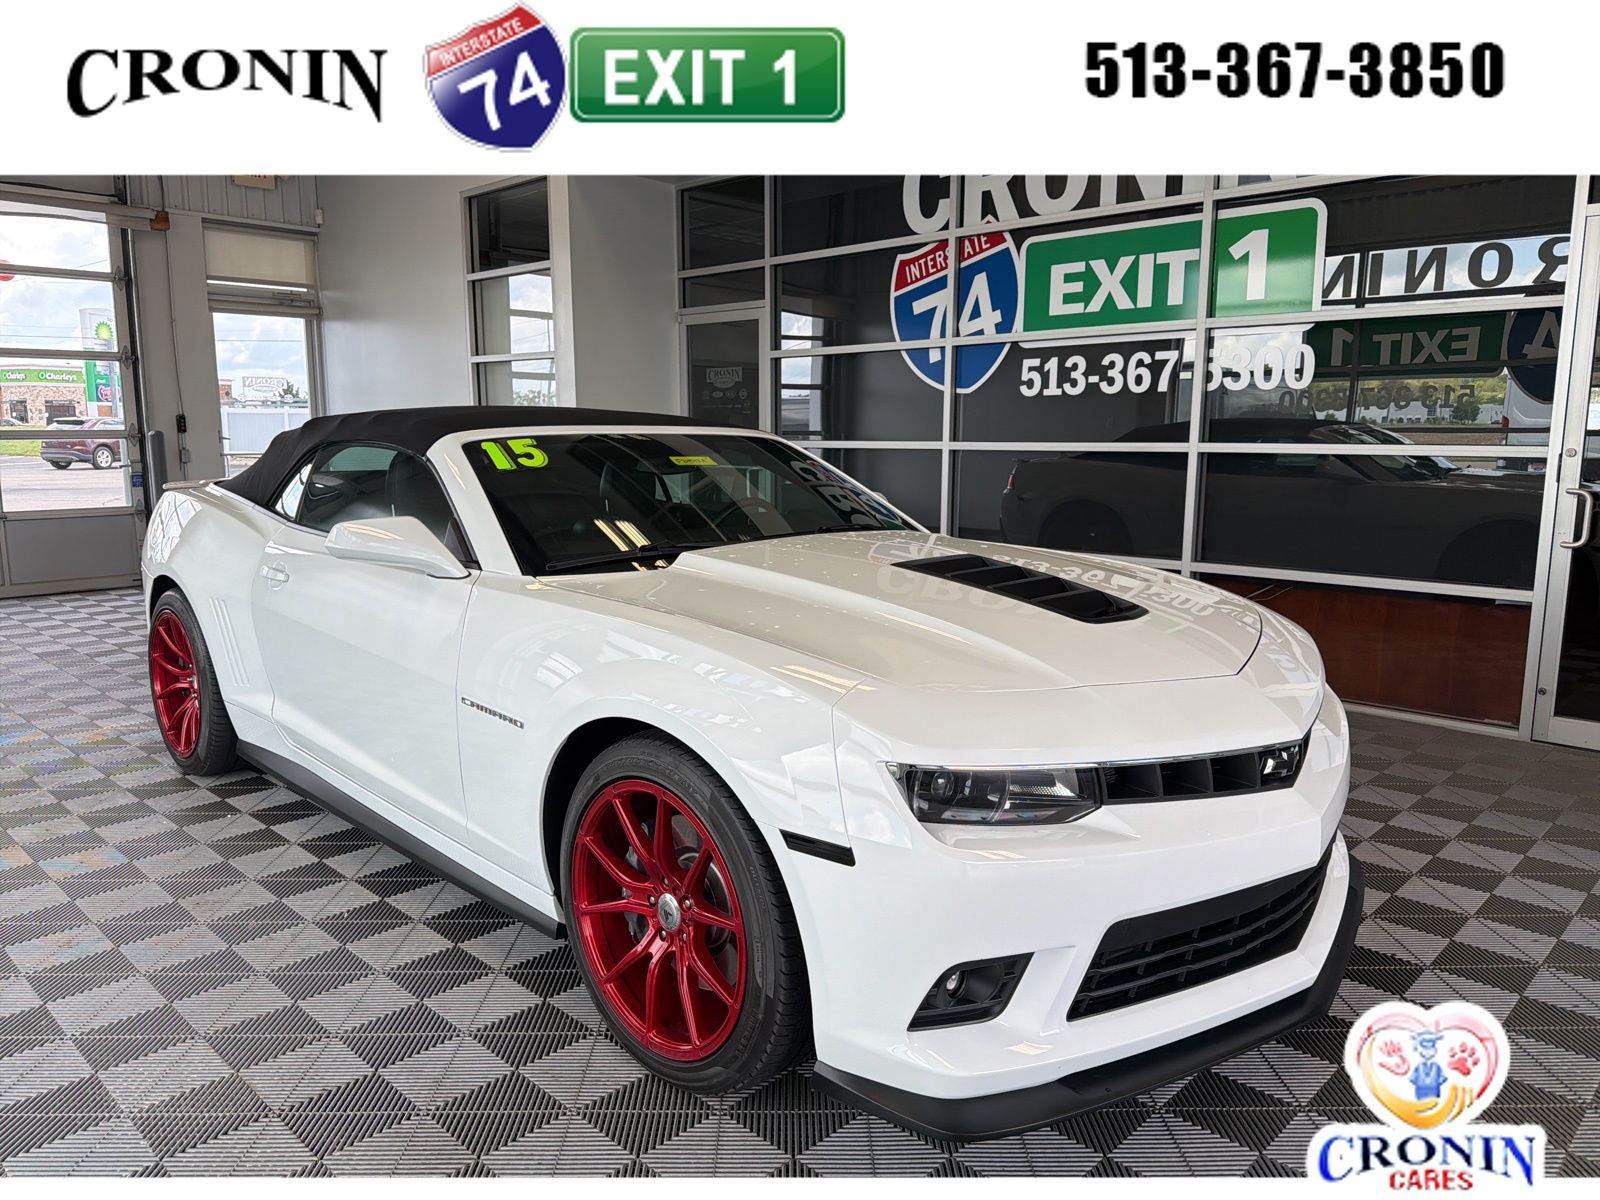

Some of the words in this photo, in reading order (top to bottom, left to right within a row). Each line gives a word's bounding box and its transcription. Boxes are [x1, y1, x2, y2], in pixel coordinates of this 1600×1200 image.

[1048, 248, 1200, 316] EXIT
[1228, 228, 1269, 300] 1
[912, 271, 1002, 363] 74
[45, 371, 77, 382] Charleys
[480, 438, 549, 471] 15
[461, 696, 525, 730] CAMARO
